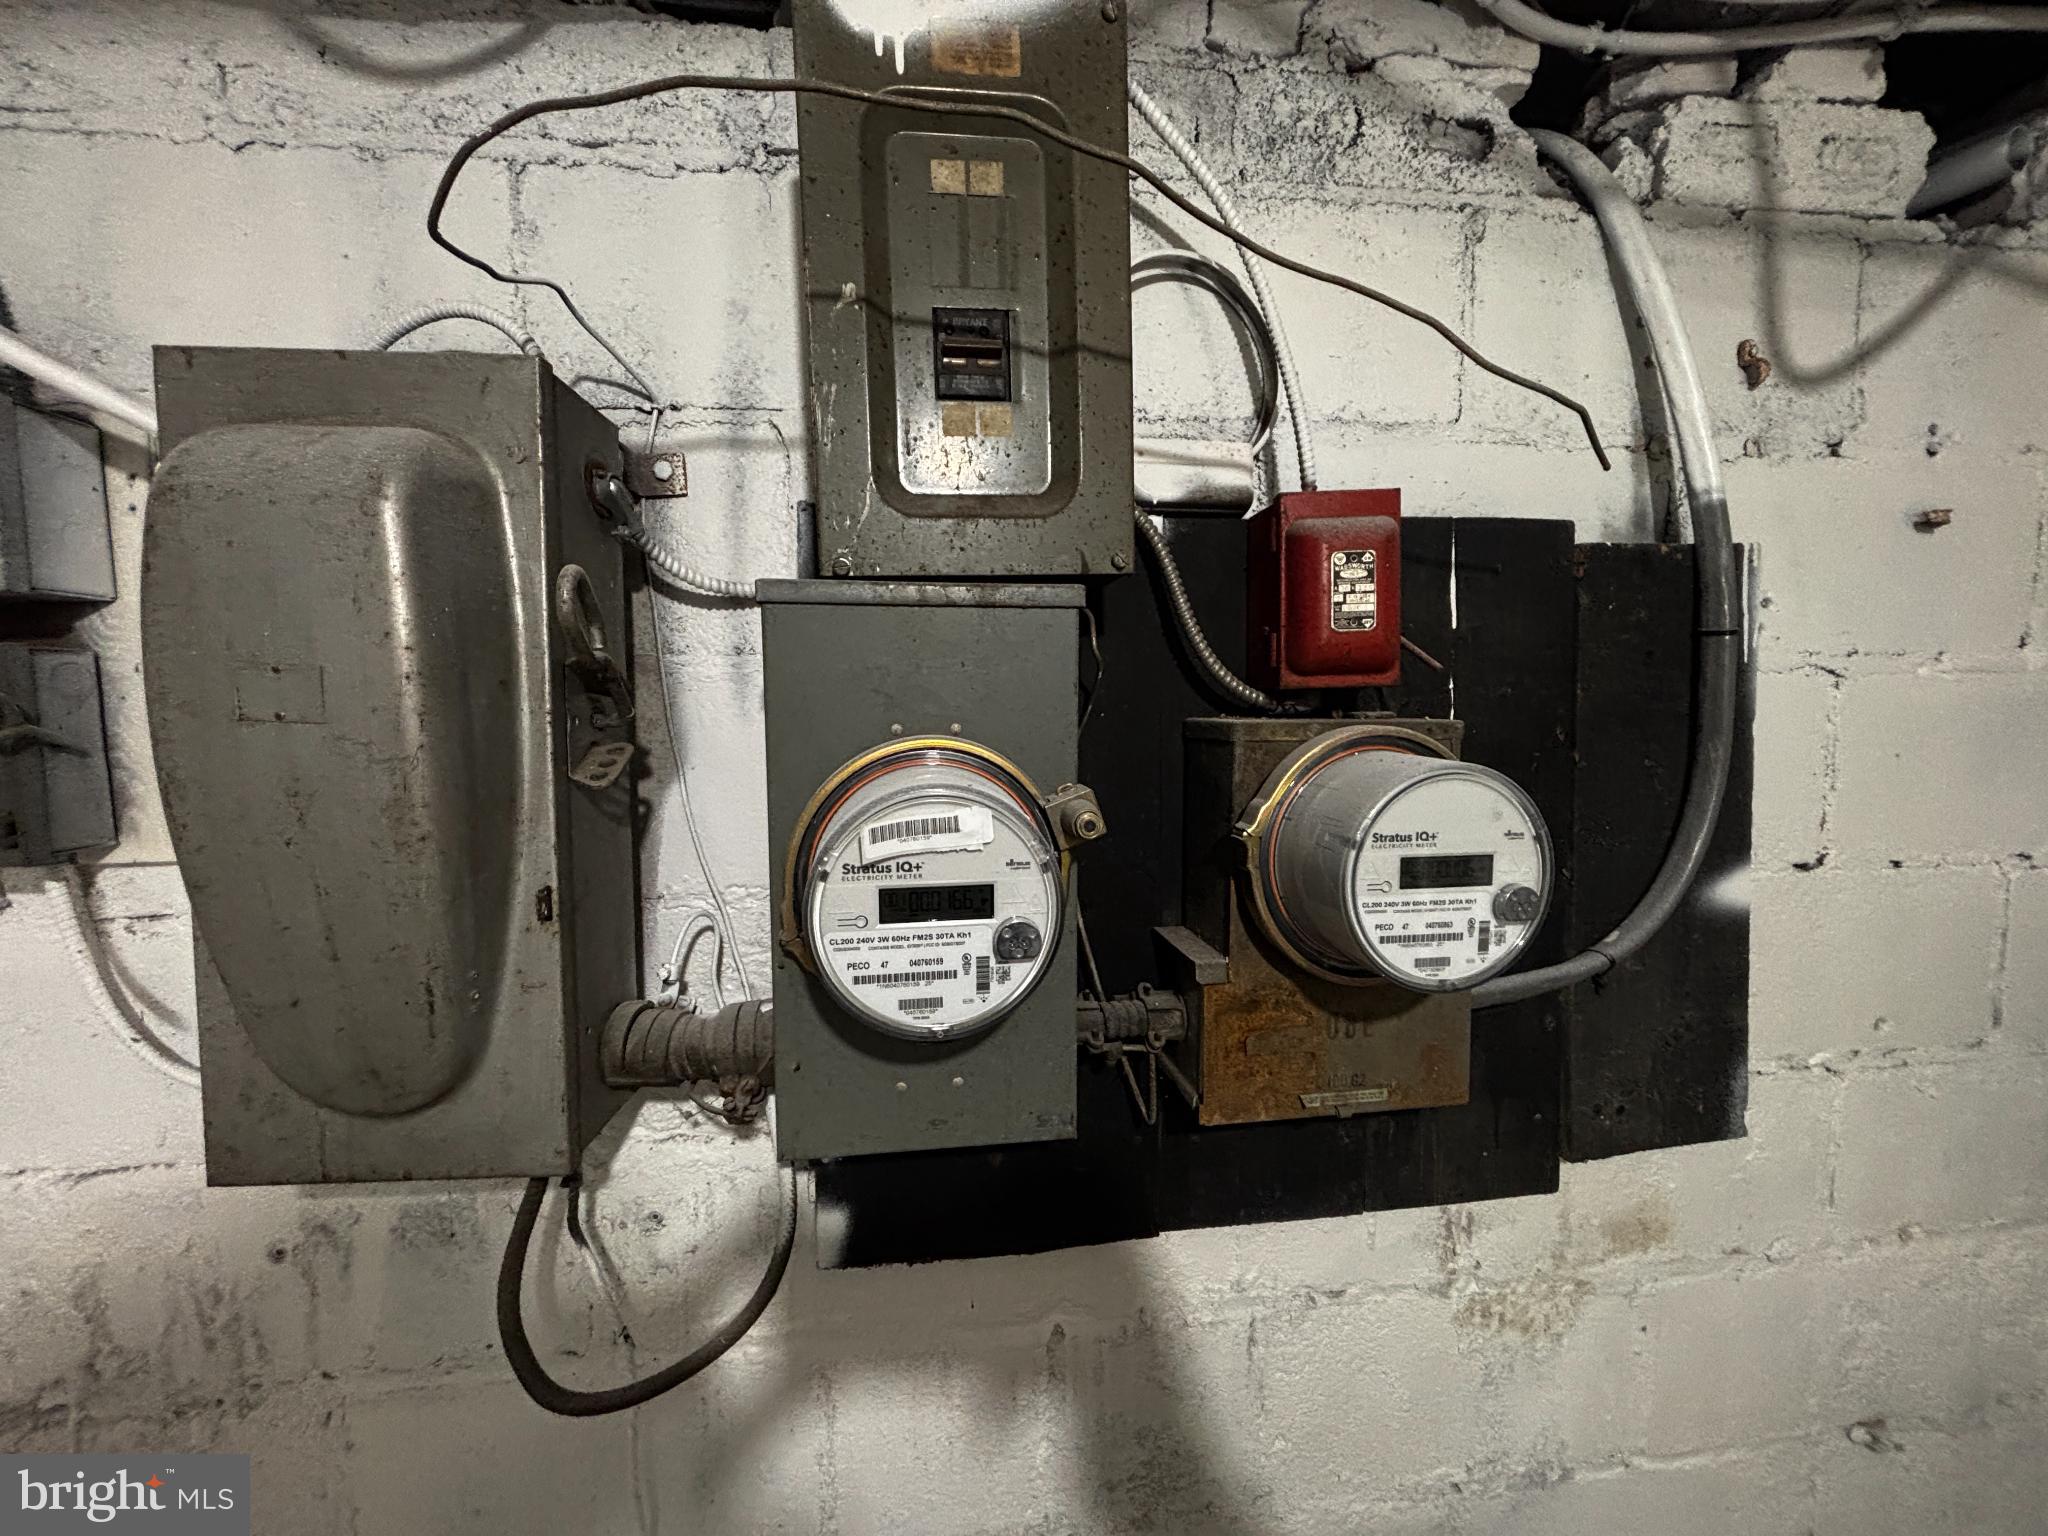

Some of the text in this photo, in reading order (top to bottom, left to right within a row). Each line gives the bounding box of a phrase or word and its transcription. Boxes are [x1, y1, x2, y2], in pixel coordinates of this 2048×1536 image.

[1371, 833, 1413, 843] Stratus
[842, 863, 892, 875] Stratus
[912, 934, 934, 942] FM2S
[957, 931, 972, 939] Kh1
[847, 957, 944, 971] PECO 47 040760159
